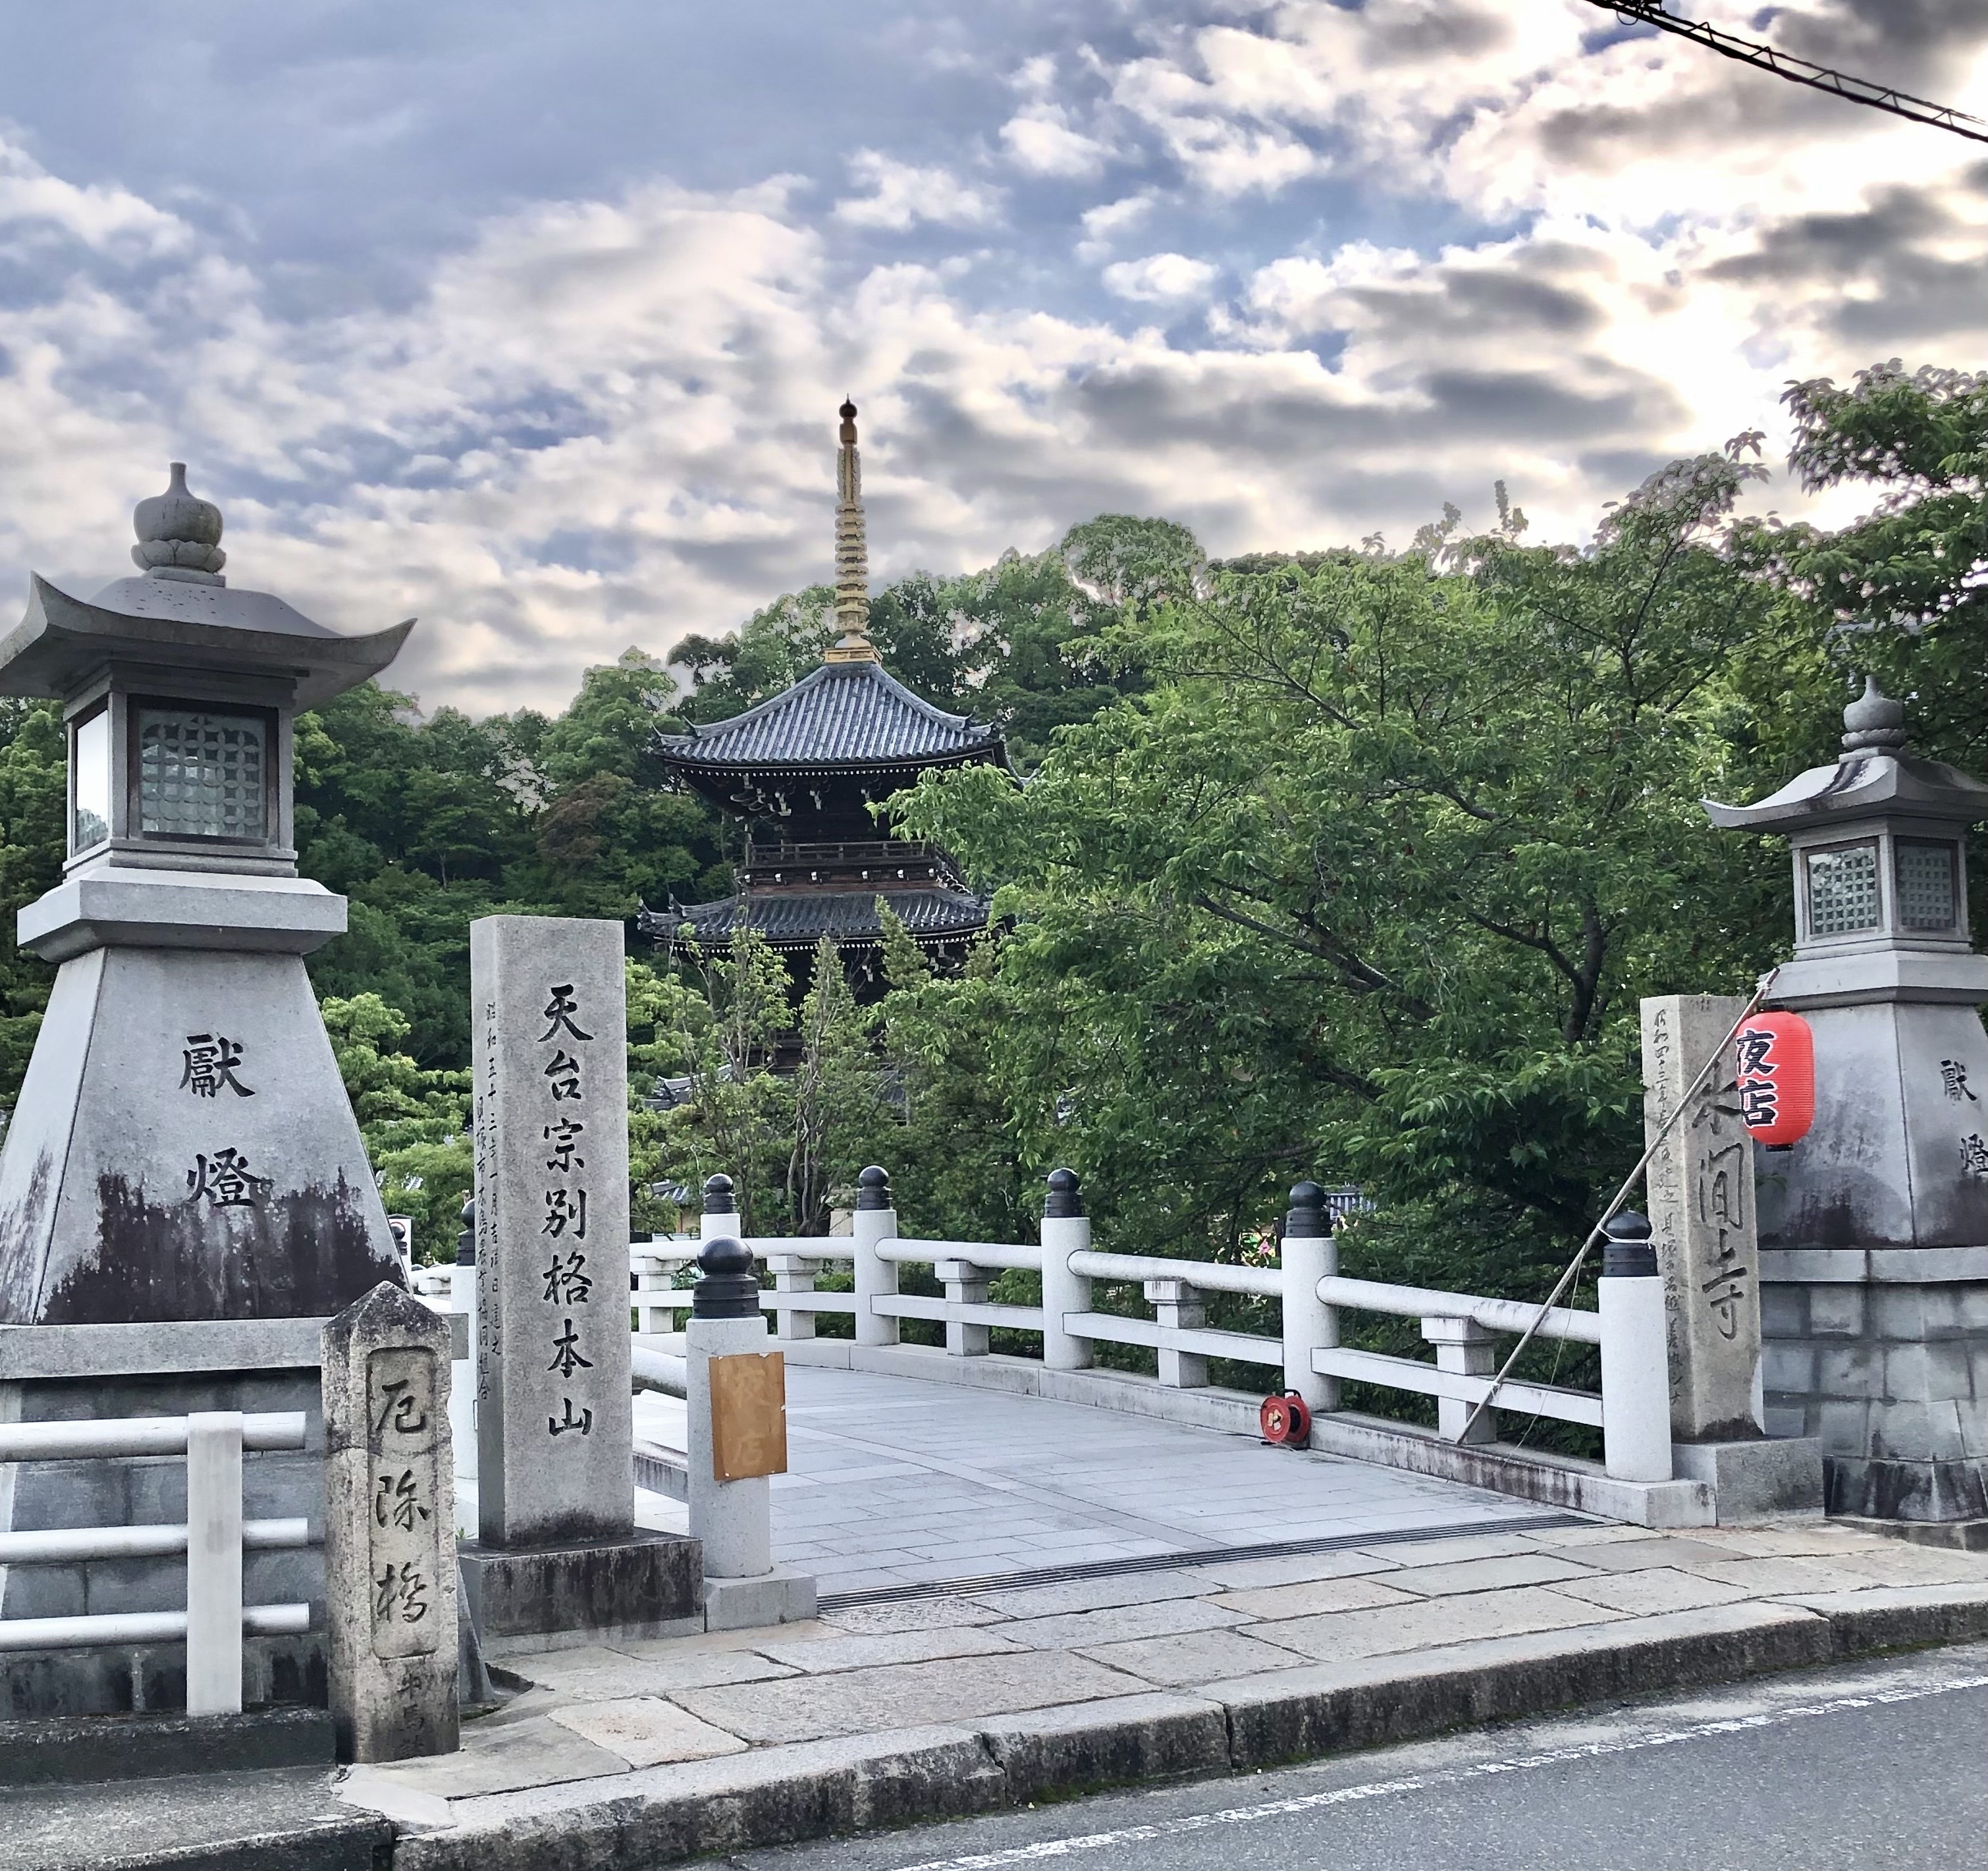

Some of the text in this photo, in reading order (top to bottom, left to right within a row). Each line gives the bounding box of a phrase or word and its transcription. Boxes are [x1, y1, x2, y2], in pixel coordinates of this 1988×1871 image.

[1736, 1028, 1778, 1127] 夜店
[537, 983, 594, 1436] 天台宗別格本山
[376, 1379, 430, 1624] 厄除橋
